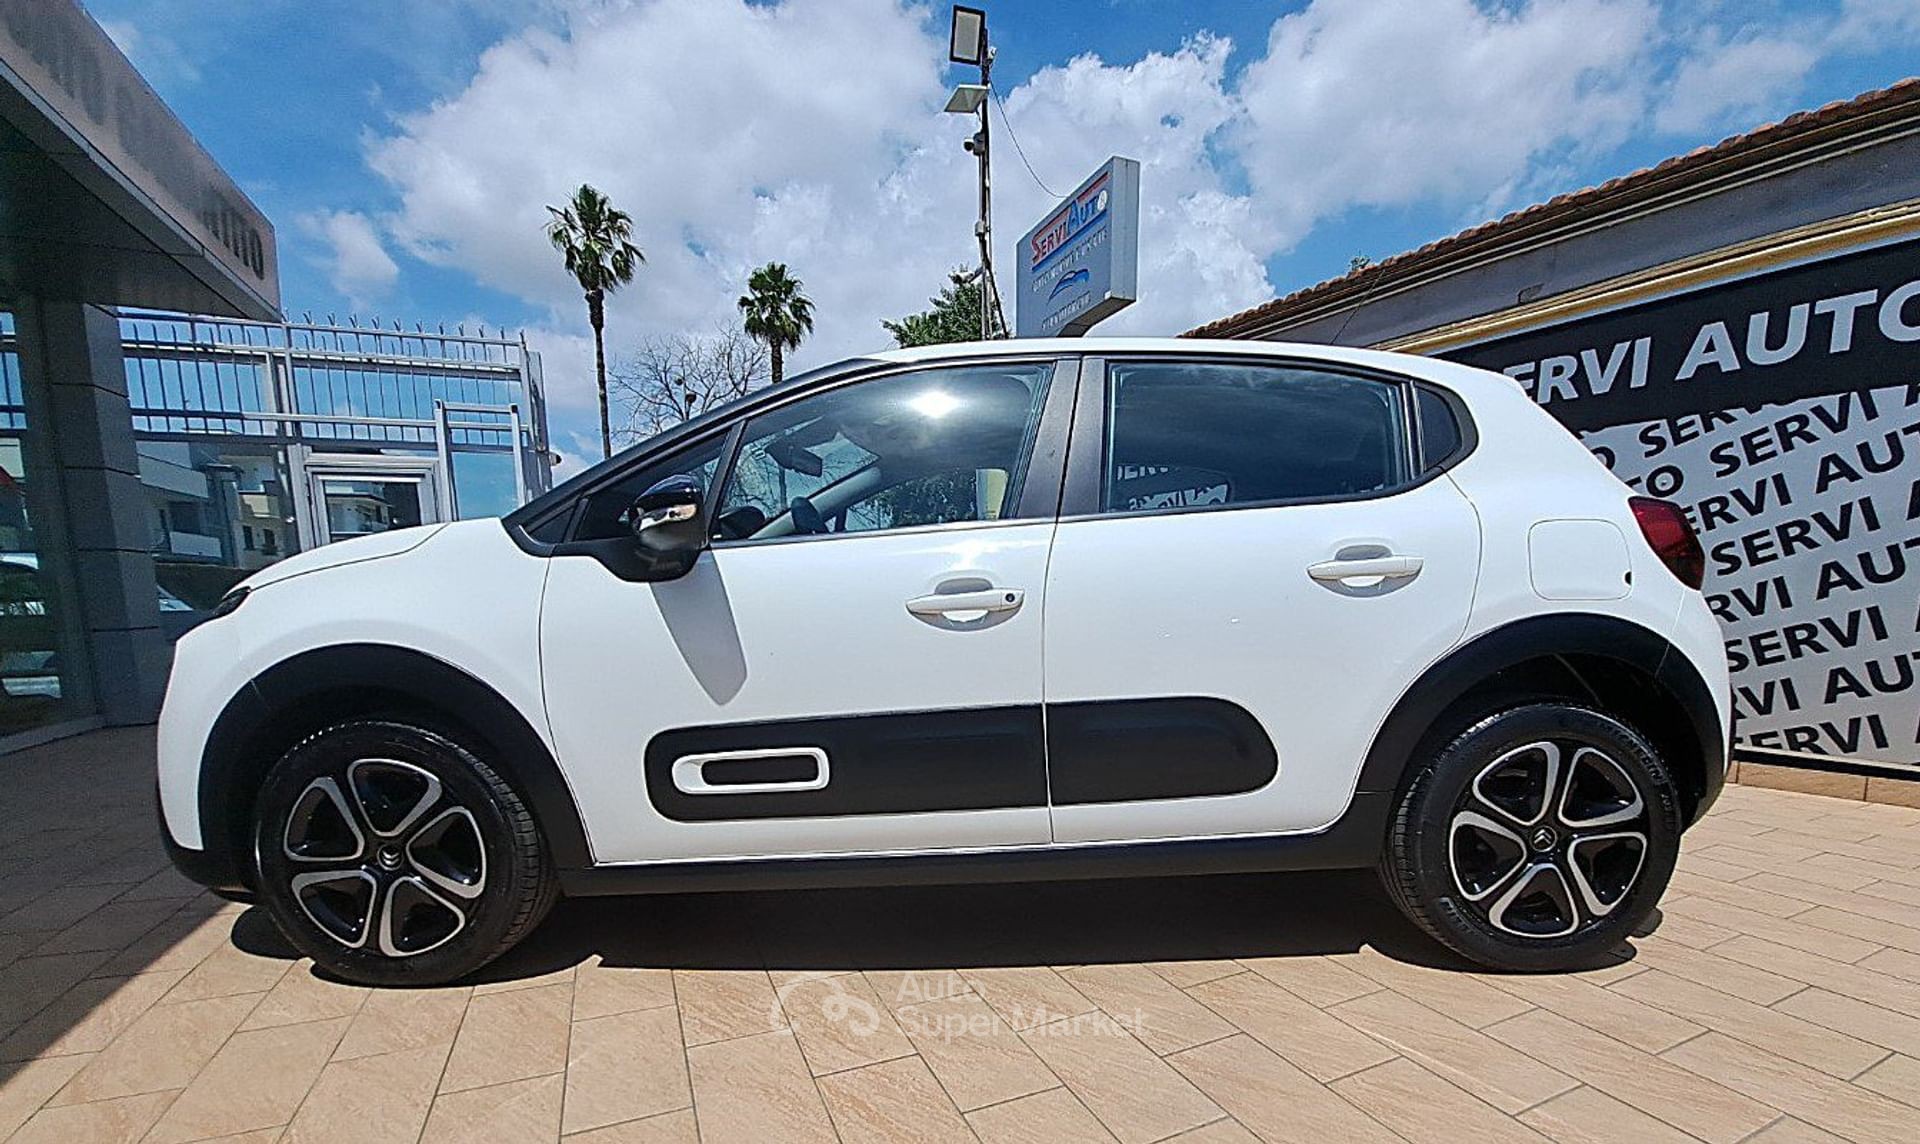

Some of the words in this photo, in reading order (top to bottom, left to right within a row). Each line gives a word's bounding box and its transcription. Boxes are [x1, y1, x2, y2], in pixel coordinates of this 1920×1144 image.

[1503, 336, 1651, 404] ERVI
[1709, 390, 1879, 478] SERVI
[1681, 472, 1793, 537] ERVI
[1815, 422, 1920, 494] AU
[1710, 496, 1882, 576] SERVI
[1704, 575, 1793, 623] RVI
[1815, 537, 1920, 600] AU
[1724, 605, 1889, 673] SERVI
[1823, 651, 1920, 705] AU
[1734, 714, 1889, 755] ERVI
